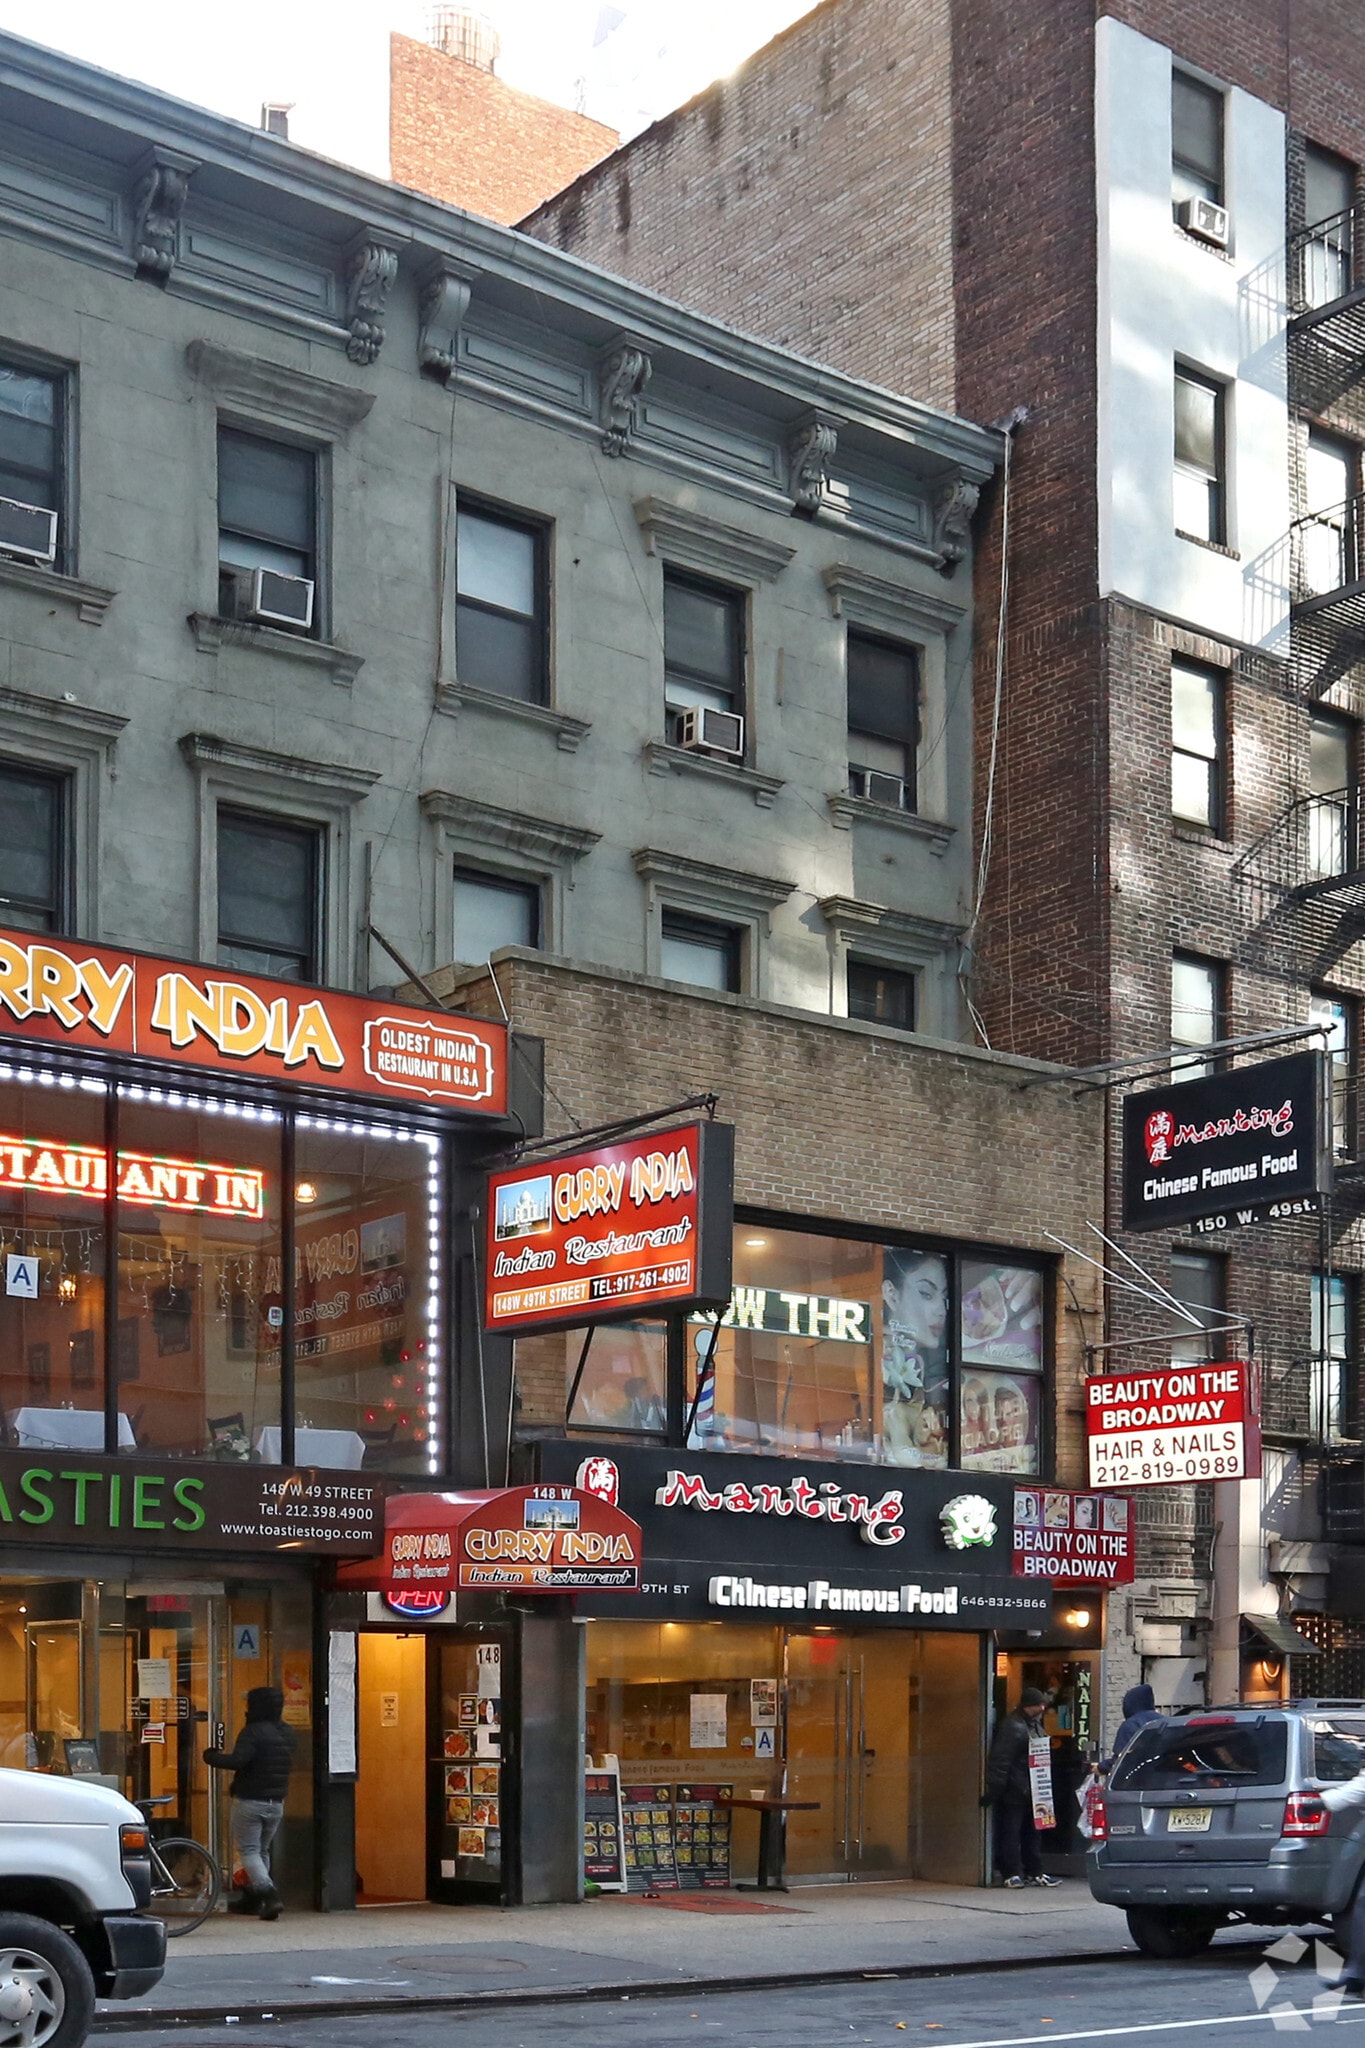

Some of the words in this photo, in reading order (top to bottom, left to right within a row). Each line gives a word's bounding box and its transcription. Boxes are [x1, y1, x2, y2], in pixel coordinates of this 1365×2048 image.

[151, 973, 344, 1067] INDIA
[381, 1028, 430, 1055] OLDEST
[434, 1038, 476, 1063] INDIAN
[378, 1051, 439, 1080] RESTAURANT
[442, 1063, 451, 1082] IN
[454, 1065, 479, 1087] U.S.A
[1173, 1100, 1293, 1147] Manting
[0, 1146, 204, 1202] TAUANT
[214, 1174, 257, 1209] IN
[555, 1160, 626, 1222] CURRY
[630, 1146, 693, 1206] INDIA
[1143, 1174, 1198, 1201] Chinese
[1202, 1163, 1257, 1189] Famous
[1261, 1149, 1298, 1177] Food
[1196, 1216, 1227, 1233] 150
[1236, 1210, 1259, 1225] W.
[493, 1247, 556, 1278] Indian
[565, 1215, 693, 1265] Restaurant
[12, 1263, 30, 1286] A
[496, 1293, 521, 1312] 148W
[523, 1290, 546, 1308] 49TH
[549, 1283, 587, 1303] STREET
[592, 1265, 688, 1296] TEL:917-261-4902
[780, 1293, 866, 1341] THR
[1089, 1378, 1164, 1405] BEAUTY
[1168, 1374, 1195, 1398] ON
[1200, 1370, 1239, 1394] THE
[1102, 1399, 1225, 1429] BROADWAY
[1095, 1439, 1143, 1461] HAIR
[1152, 1438, 1165, 1456] &
[1172, 1431, 1236, 1454] NAILS
[1097, 1456, 1238, 1483] 212-819-0989
[262, 1483, 286, 1496] 148
[289, 1484, 303, 1497] W
[305, 1485, 321, 1498] 49
[324, 1486, 373, 1500] STREET
[532, 1487, 555, 1499] 148
[560, 1488, 572, 1500] W
[259, 1503, 281, 1516] Tel.
[286, 1505, 373, 1520] 212.398.4900
[659, 1470, 905, 1546] Manting
[221, 1522, 373, 1541] www.toastiestogo.com
[1014, 1530, 1073, 1553] BEAUTY
[1076, 1534, 1096, 1554] ON
[1100, 1535, 1128, 1556] THE
[392, 1535, 423, 1561] CURRY
[424, 1534, 451, 1560] INDIA
[465, 1529, 555, 1562] CURRY
[561, 1532, 634, 1563] INDIA
[469, 1567, 523, 1584] Indian
[530, 1567, 632, 1588] Restaurant
[1024, 1556, 1117, 1578] BROADWAY
[387, 1591, 443, 1607] OPEN
[638, 1584, 667, 1593] 9TH
[673, 1585, 690, 1594] ST
[710, 1576, 806, 1611] Chinese
[808, 1580, 900, 1614] Famous
[902, 1585, 959, 1615] Food
[238, 1629, 255, 1650] A
[478, 1647, 500, 1664] 148
[758, 1731, 771, 1748] A
